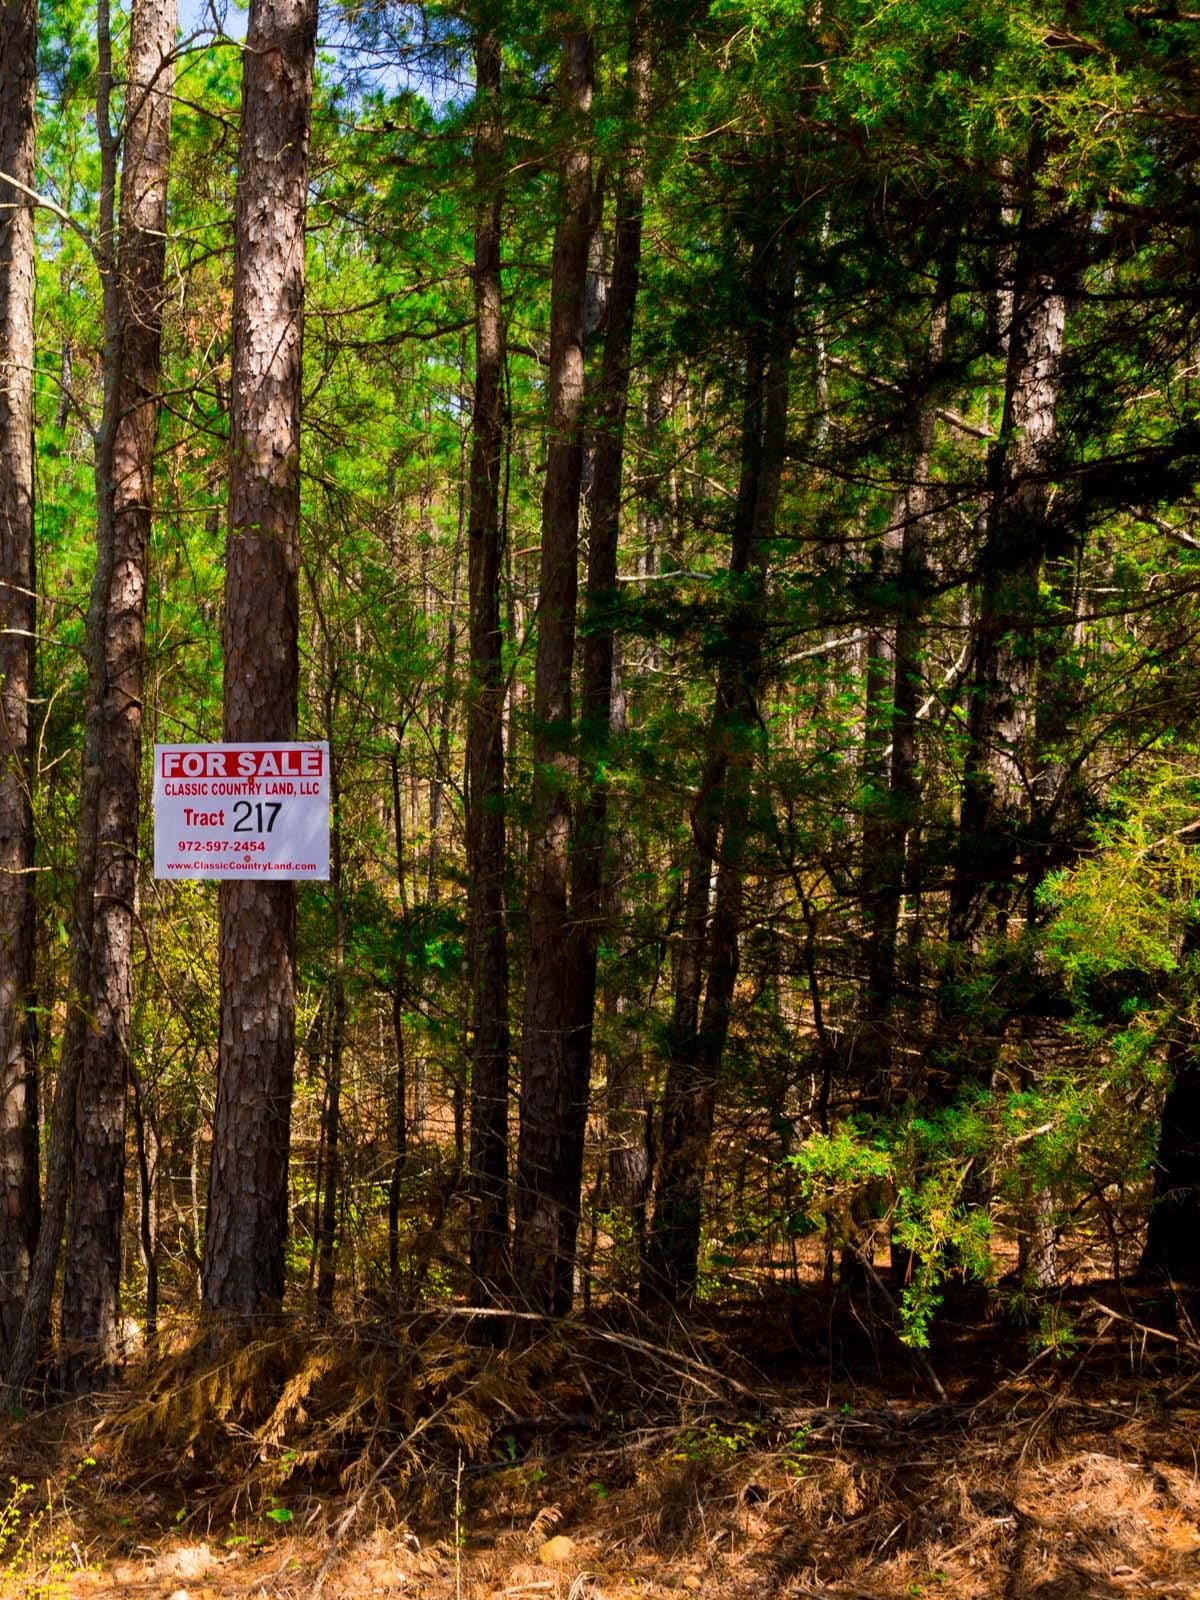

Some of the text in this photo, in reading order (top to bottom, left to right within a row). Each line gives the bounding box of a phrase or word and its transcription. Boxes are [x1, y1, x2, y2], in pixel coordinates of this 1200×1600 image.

[164, 752, 320, 776] FOR SALE
[165, 782, 320, 797] CLASSIC COUNTRY LAND, LLC
[184, 800, 282, 832] Tract 217
[178, 841, 266, 852] 972-597-2454
[166, 861, 316, 872] www.ClassicCountryLand.com
